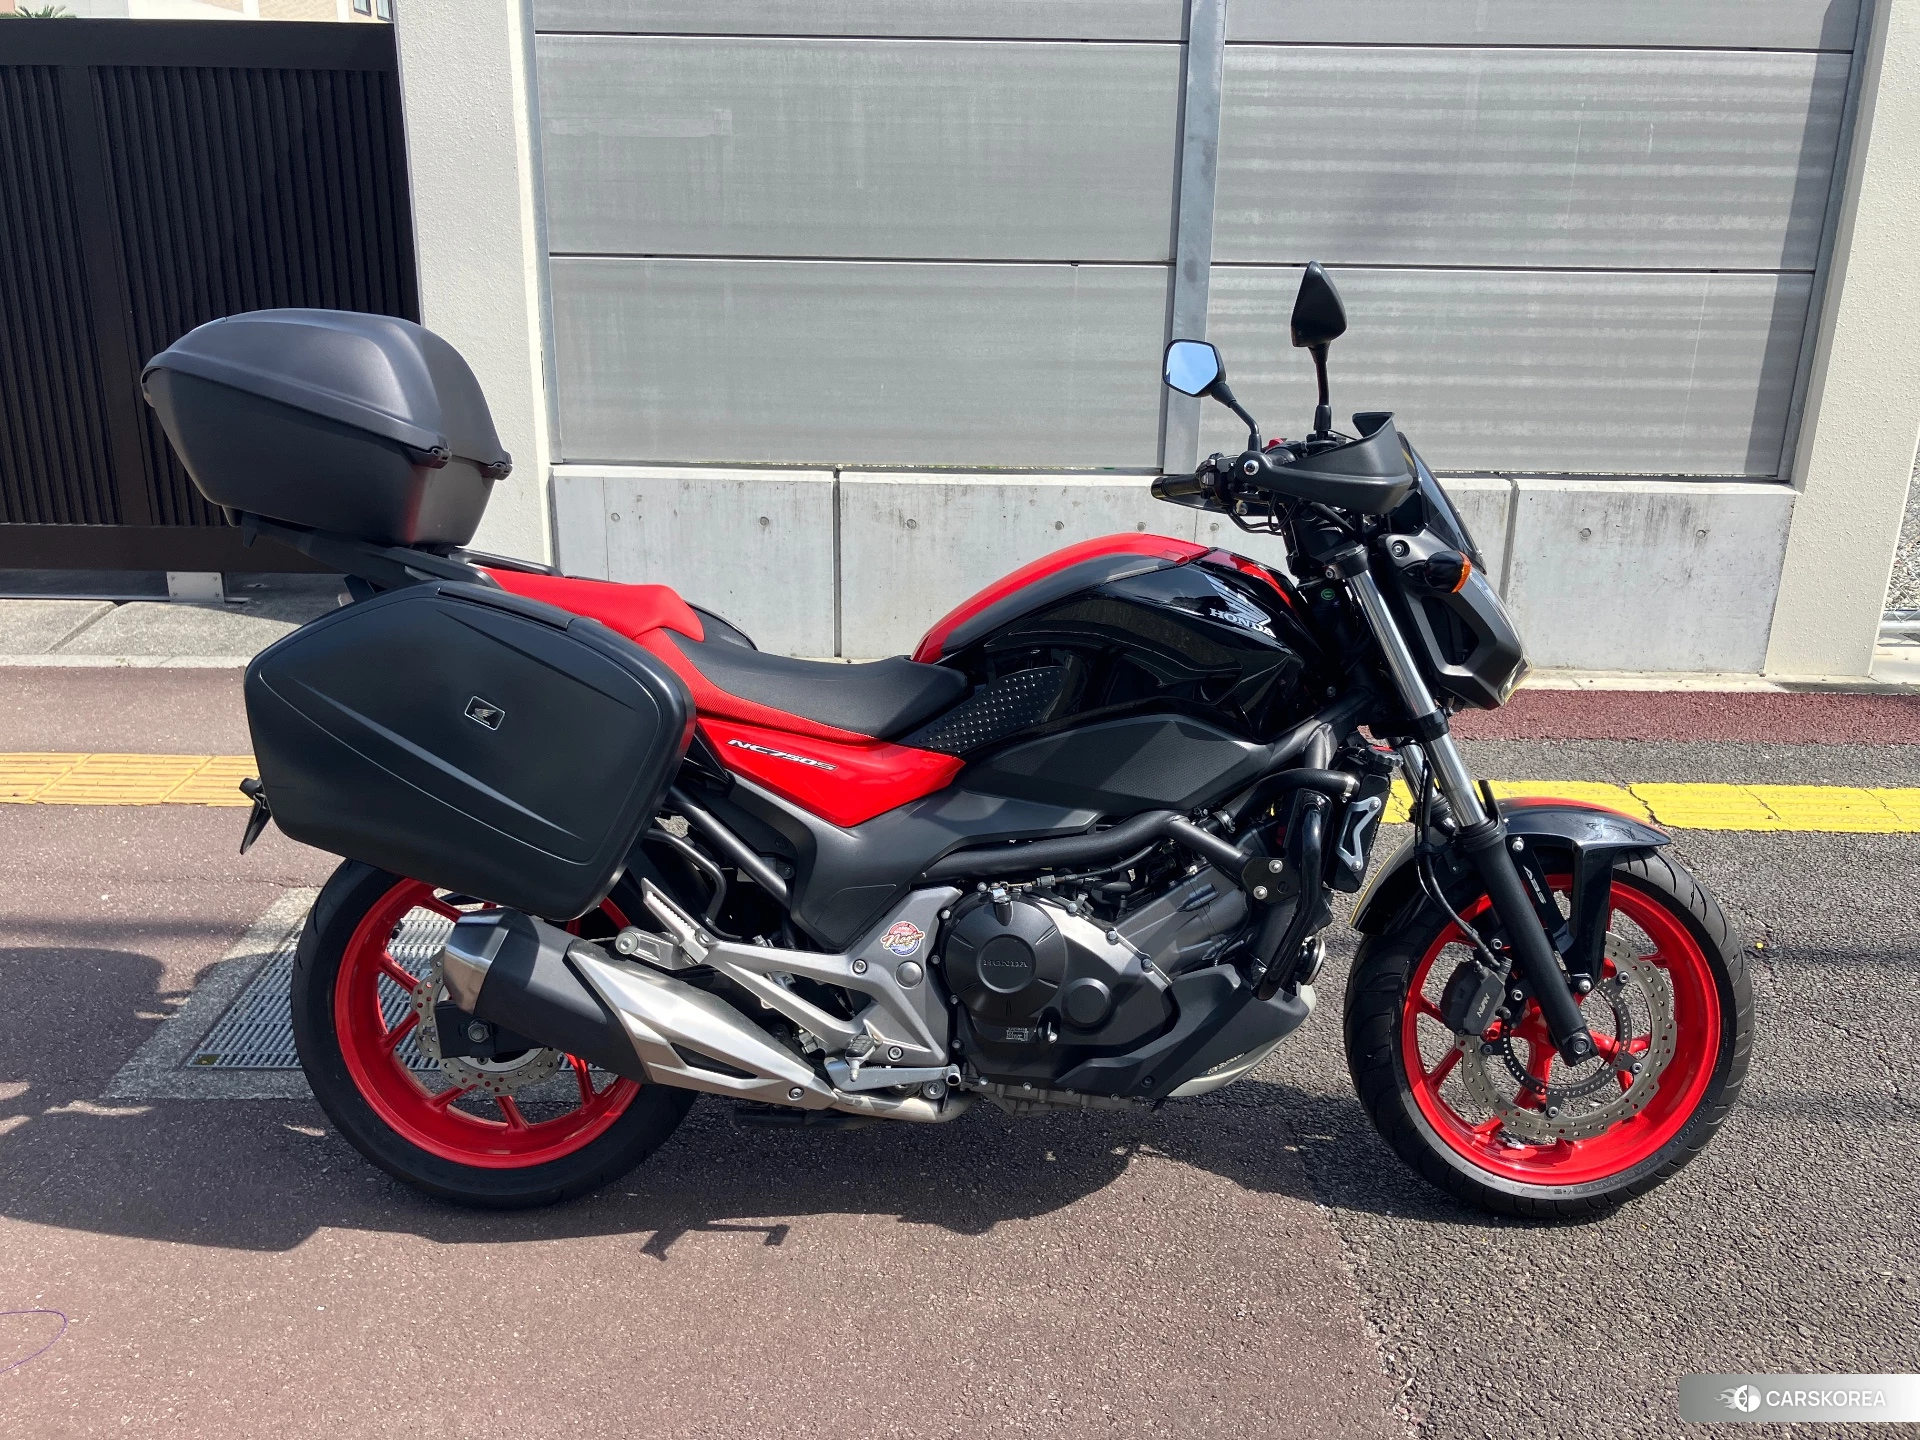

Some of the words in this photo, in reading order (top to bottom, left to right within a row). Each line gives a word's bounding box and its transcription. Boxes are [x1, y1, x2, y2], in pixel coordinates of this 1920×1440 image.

[1209, 607, 1277, 638] HONDA
[1522, 865, 1547, 904] ABS
[983, 959, 1028, 968] HONDA
